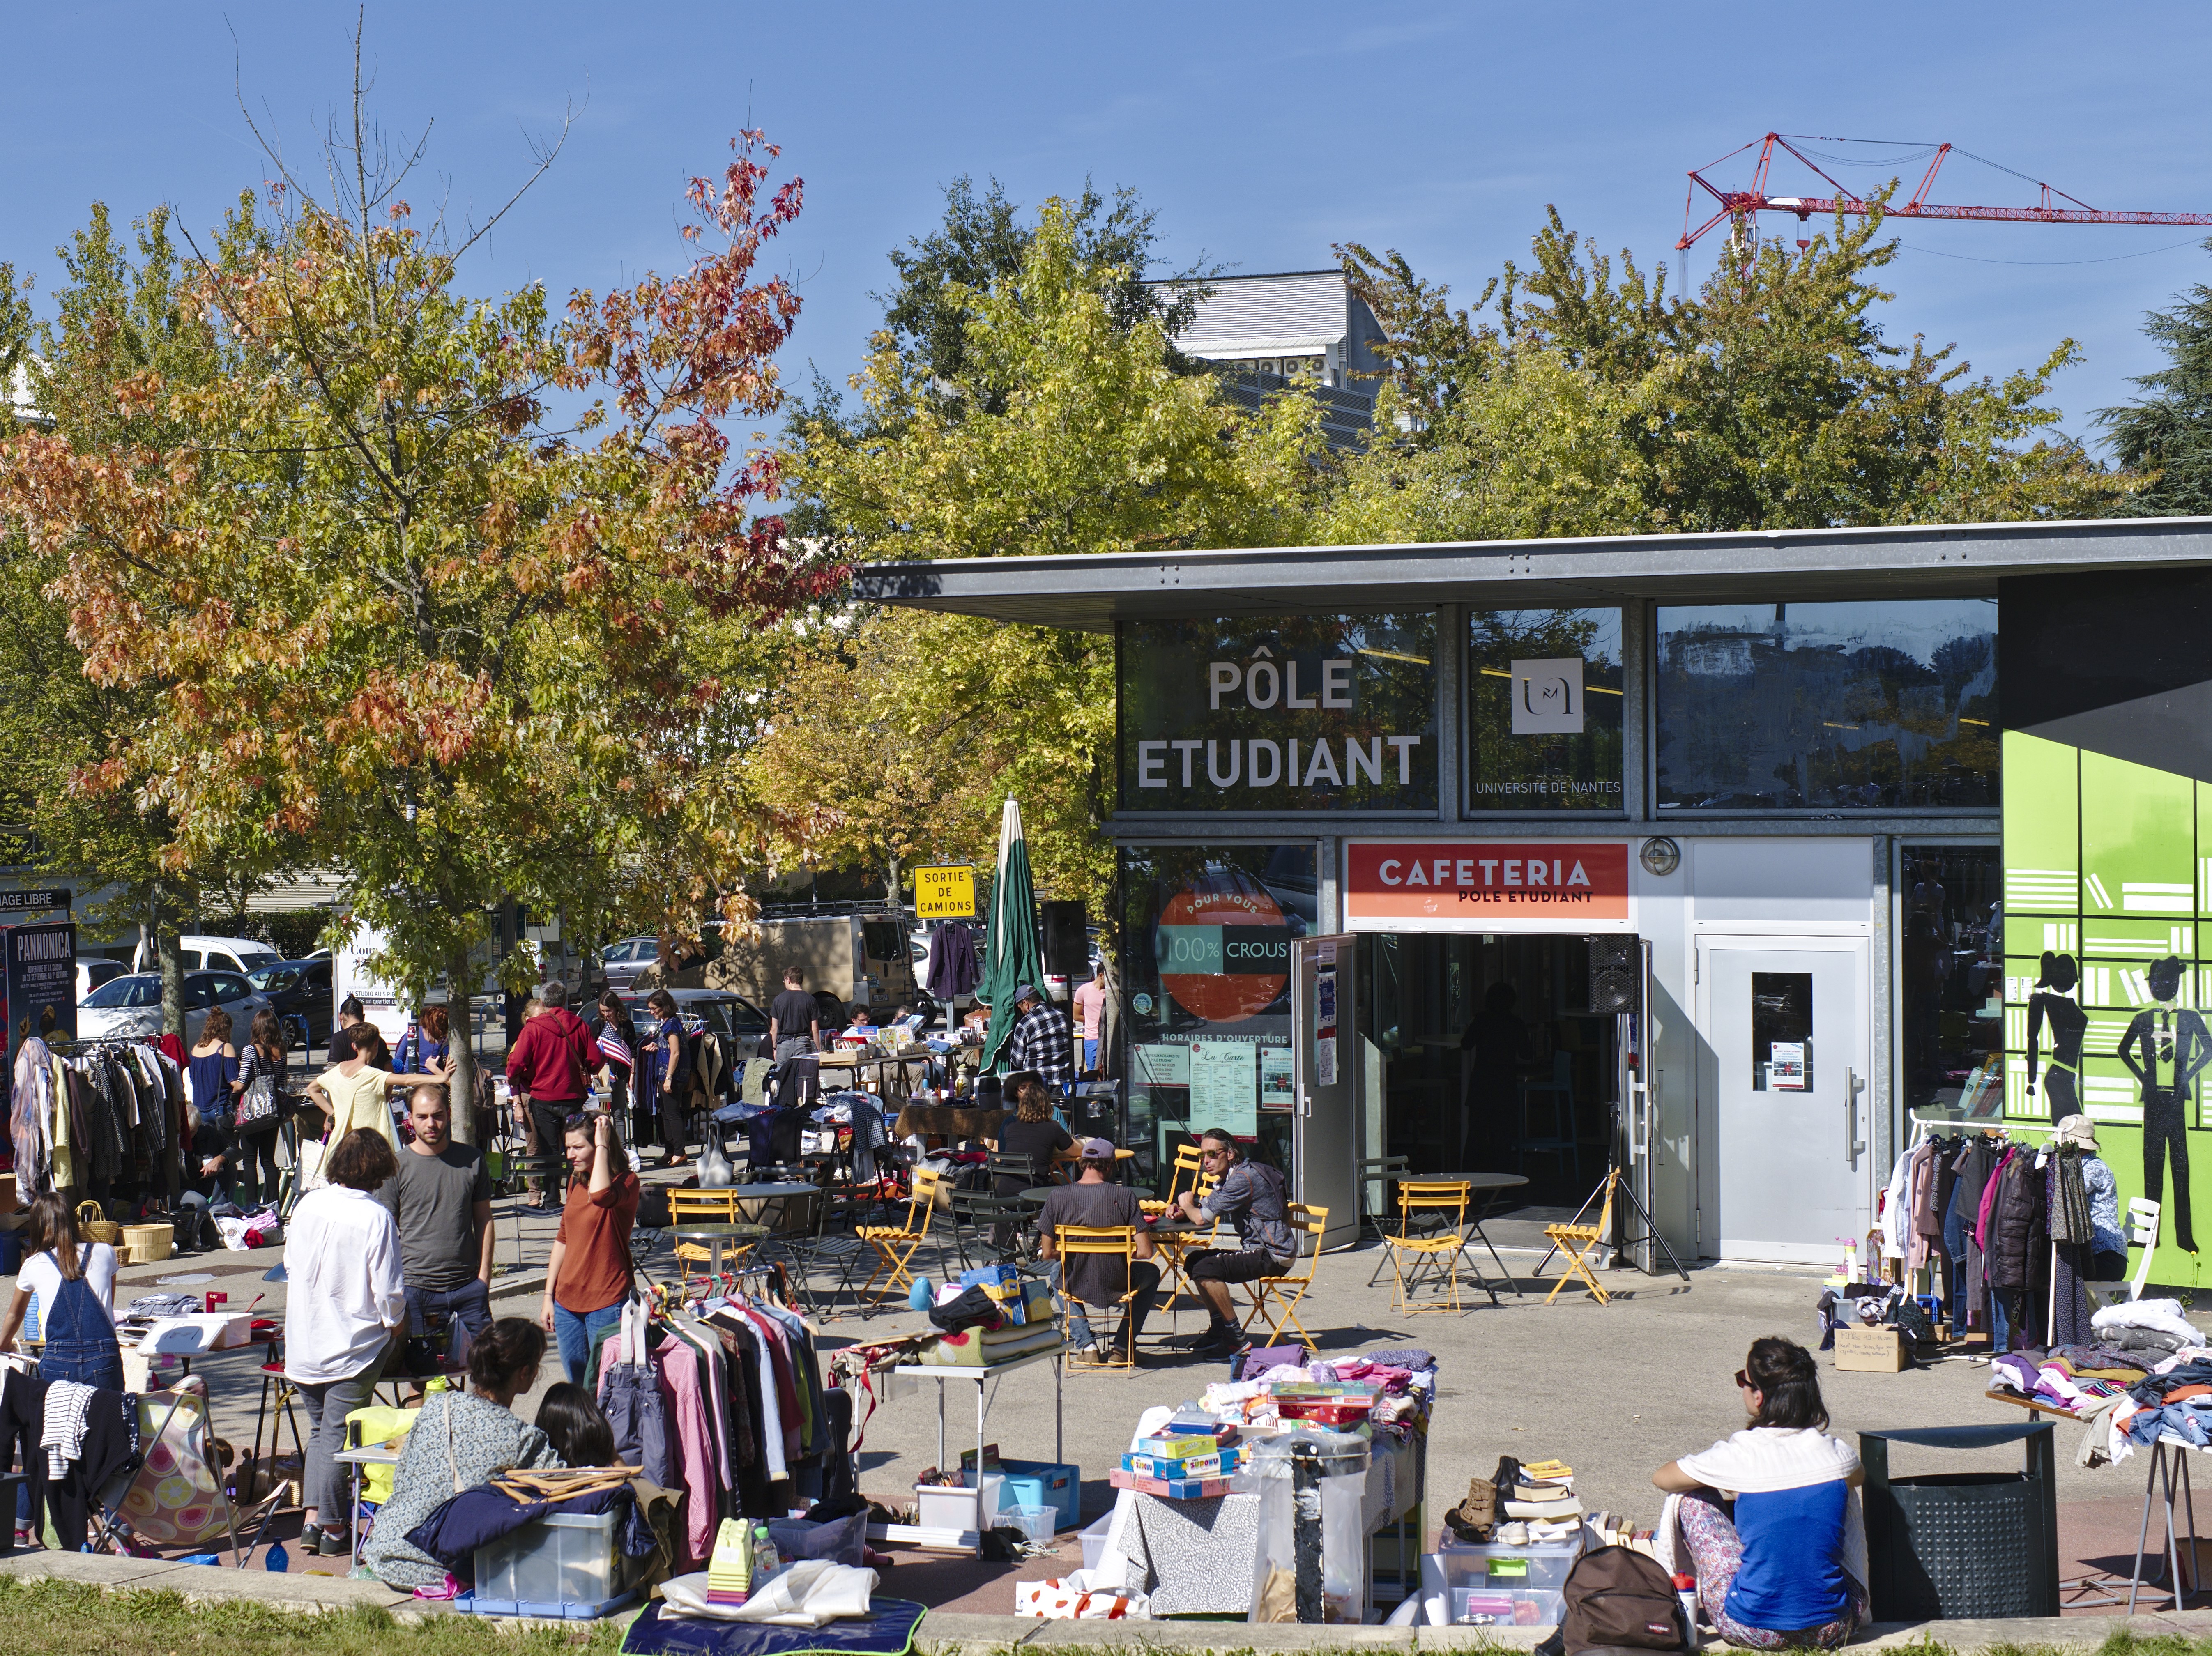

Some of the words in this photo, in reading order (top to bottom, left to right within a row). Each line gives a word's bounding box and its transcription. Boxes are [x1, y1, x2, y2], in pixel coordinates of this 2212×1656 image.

[1210, 646, 1352, 709] PÔLE
[1138, 736, 1420, 788] ETUDIANT
[1476, 780, 1547, 794] UNIVERSITÉ
[1551, 782, 1568, 793] DE
[1571, 781, 1620, 793] NANTES
[925, 872, 964, 883] SORTIE
[1379, 859, 1591, 886] CAFETERIA
[938, 887, 952, 897] DE
[1459, 890, 1501, 903] POLE
[1508, 890, 1593, 903] ETUDIANT
[24, 893, 52, 905] LIBRE
[1187, 893, 1220, 914] POUR
[1227, 893, 1258, 914] VOUS
[920, 902, 971, 912] CAMIONS
[17, 932, 71, 961] PANNONICA
[1169, 938, 1219, 961] 100%
[1227, 942, 1287, 957] CROUS
[1162, 1033, 1212, 1042] HORAIRES
[1216, 1034, 1287, 1044] D'OUVERTURE
[1201, 1049, 1217, 1060] La
[1220, 1052, 1245, 1063] Carte
[1297, 1405, 1319, 1413] PICTIONARY
[1136, 1461, 1152, 1471] SUDOKU
[1190, 1458, 1218, 1468] SUDOKU
